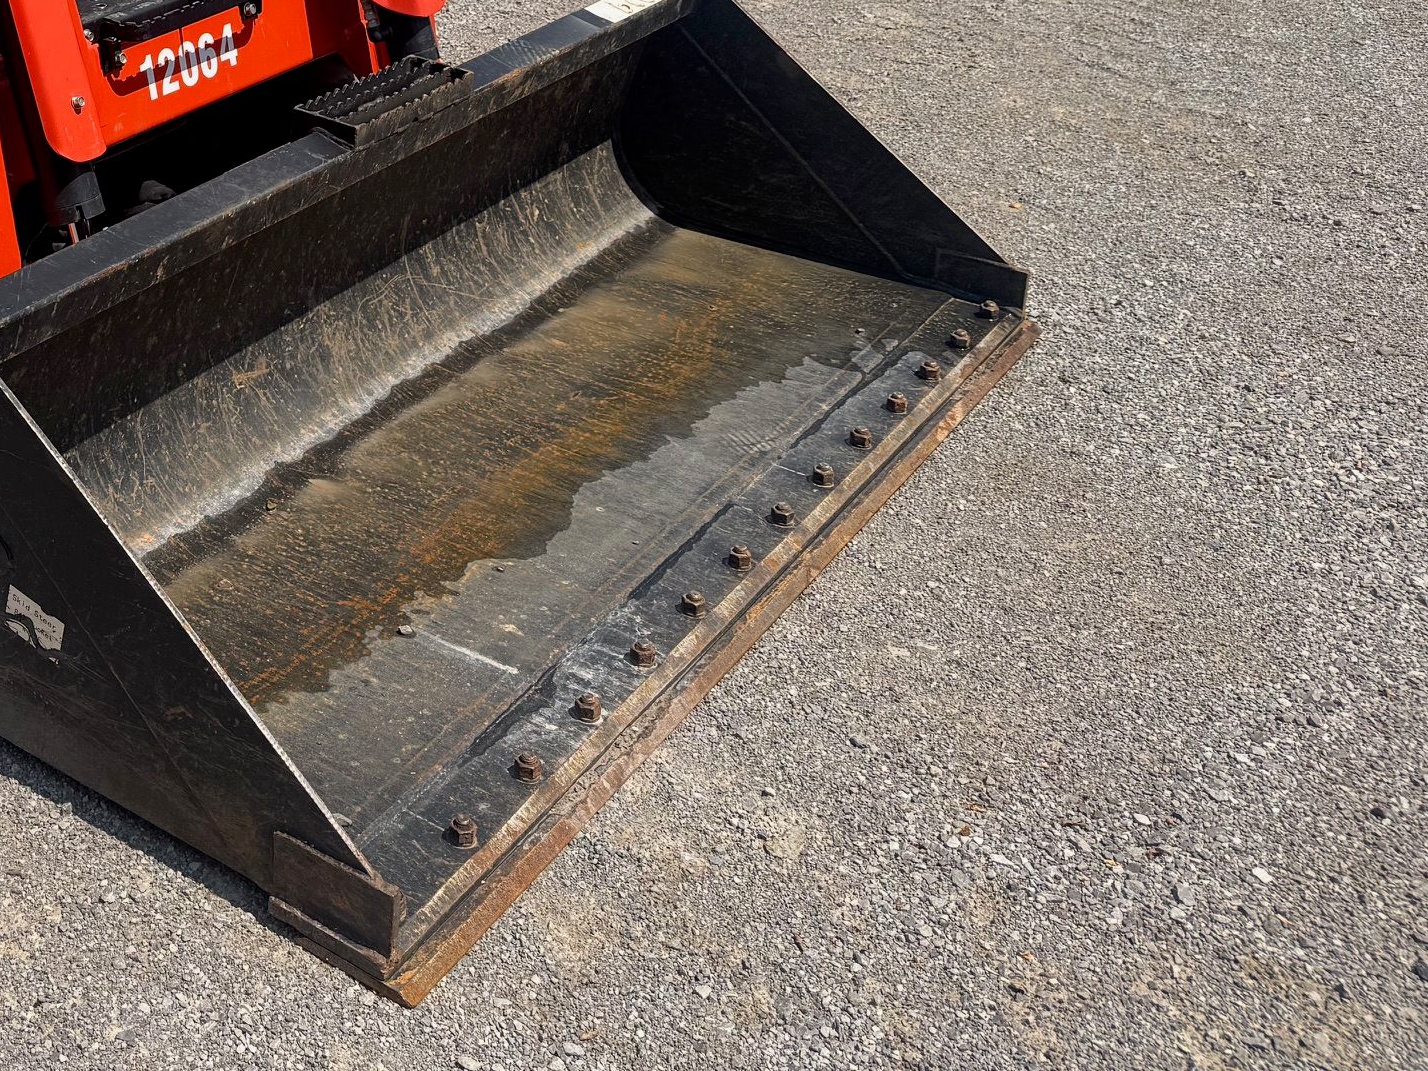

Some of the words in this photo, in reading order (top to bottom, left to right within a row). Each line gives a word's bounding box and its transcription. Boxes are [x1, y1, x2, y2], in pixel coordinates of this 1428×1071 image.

[139, 23, 238, 100] 12064
[12, 593, 30, 611] Skid
[33, 610, 57, 630] Steer
